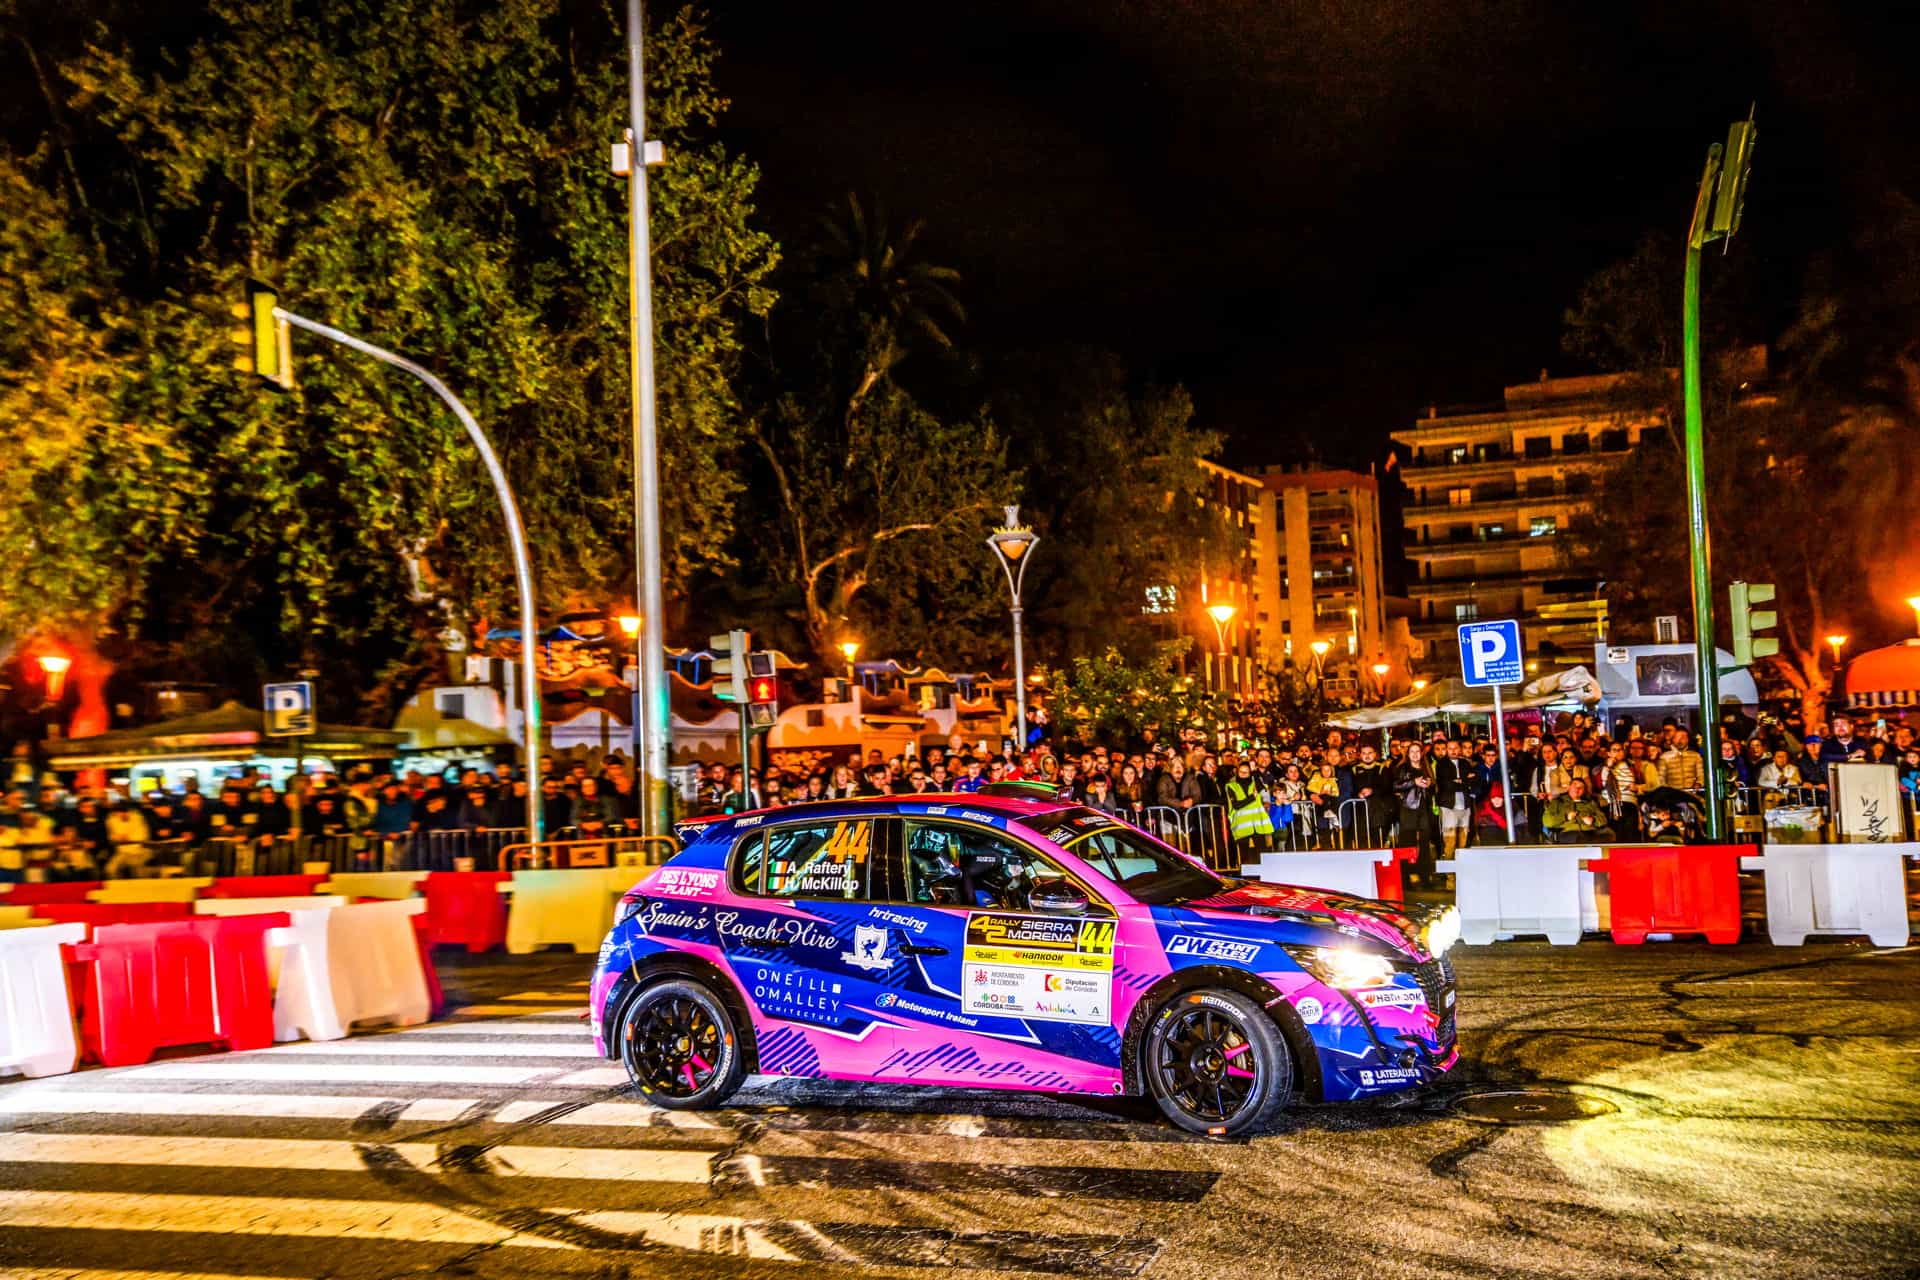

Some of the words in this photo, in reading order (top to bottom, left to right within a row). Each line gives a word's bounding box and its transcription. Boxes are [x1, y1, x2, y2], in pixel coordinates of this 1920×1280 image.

[1470, 631, 1506, 679] P
[827, 821, 870, 864] 44
[803, 861, 850, 877] Raftery
[658, 870, 681, 885] DES
[680, 871, 719, 889] LYONS
[802, 876, 859, 892] McKillop
[663, 885, 702, 897] PLANT
[642, 902, 711, 931] Spain's
[714, 911, 781, 940] Coach
[783, 919, 840, 950] Hire
[868, 906, 929, 934] hrtracing
[989, 918, 1021, 927] RALLY
[1021, 920, 1075, 933] SIERRA
[1007, 929, 1073, 943] MORENA
[1079, 921, 1112, 953] 44
[1204, 947, 1249, 961] SALES
[1209, 940, 1251, 953] PLANT
[896, 999, 945, 1019] Motorsport
[946, 1011, 979, 1027] Ireland
